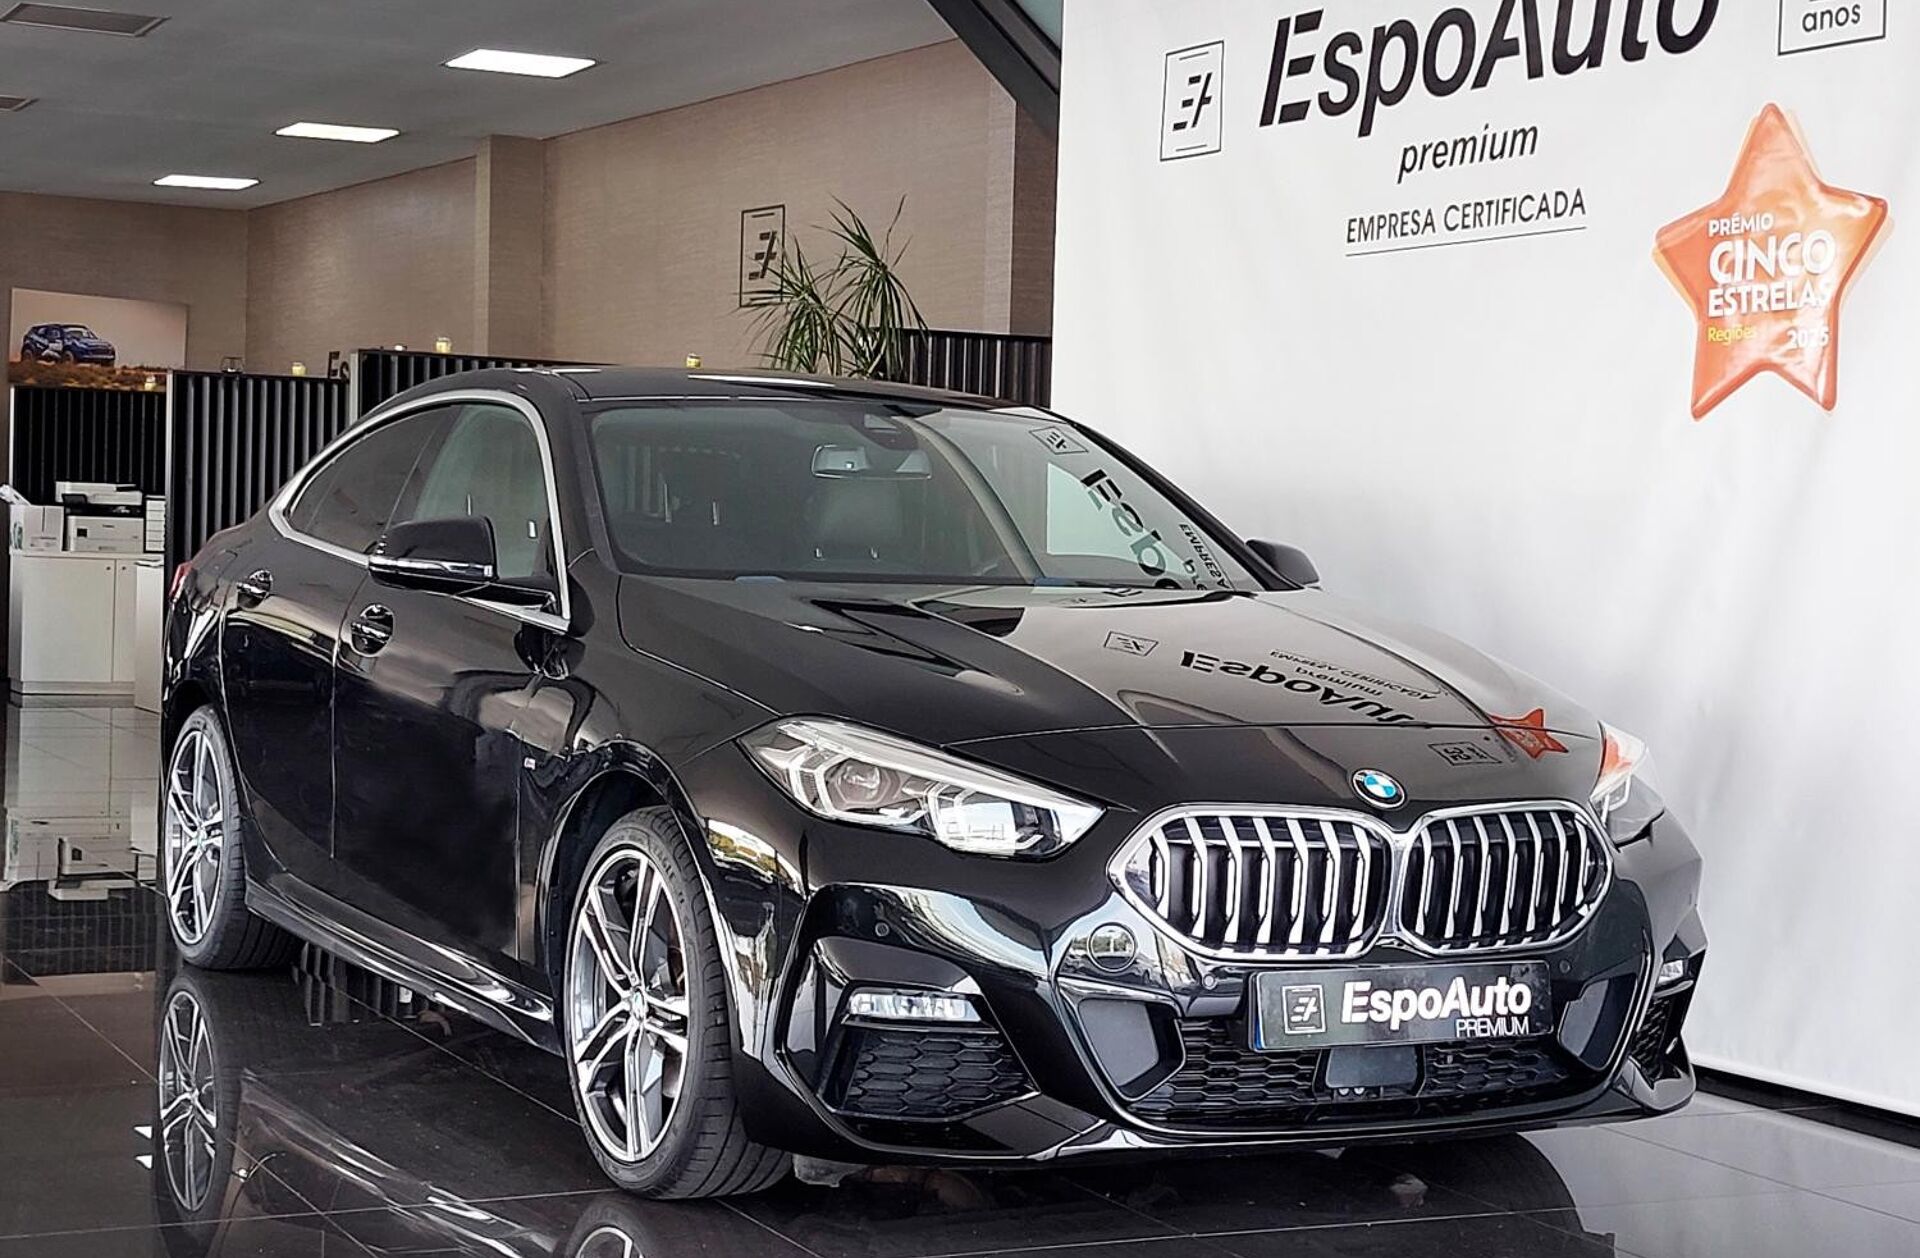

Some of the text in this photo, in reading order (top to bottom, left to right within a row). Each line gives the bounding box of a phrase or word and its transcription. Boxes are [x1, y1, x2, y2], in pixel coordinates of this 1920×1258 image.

[1802, 4, 1861, 33] anos
[1259, 0, 1720, 137] EspoAuto
[1397, 123, 1539, 184] premium
[1346, 187, 1587, 244] EMPRESA CERTIFICADA
[1709, 212, 1774, 237] PRÉMIO
[1709, 229, 1836, 285] CINCO
[1708, 279, 1833, 318] ESTRELAS
[1341, 976, 1532, 1031] EspoAuto
[1456, 1016, 1529, 1037] PREMIUM
